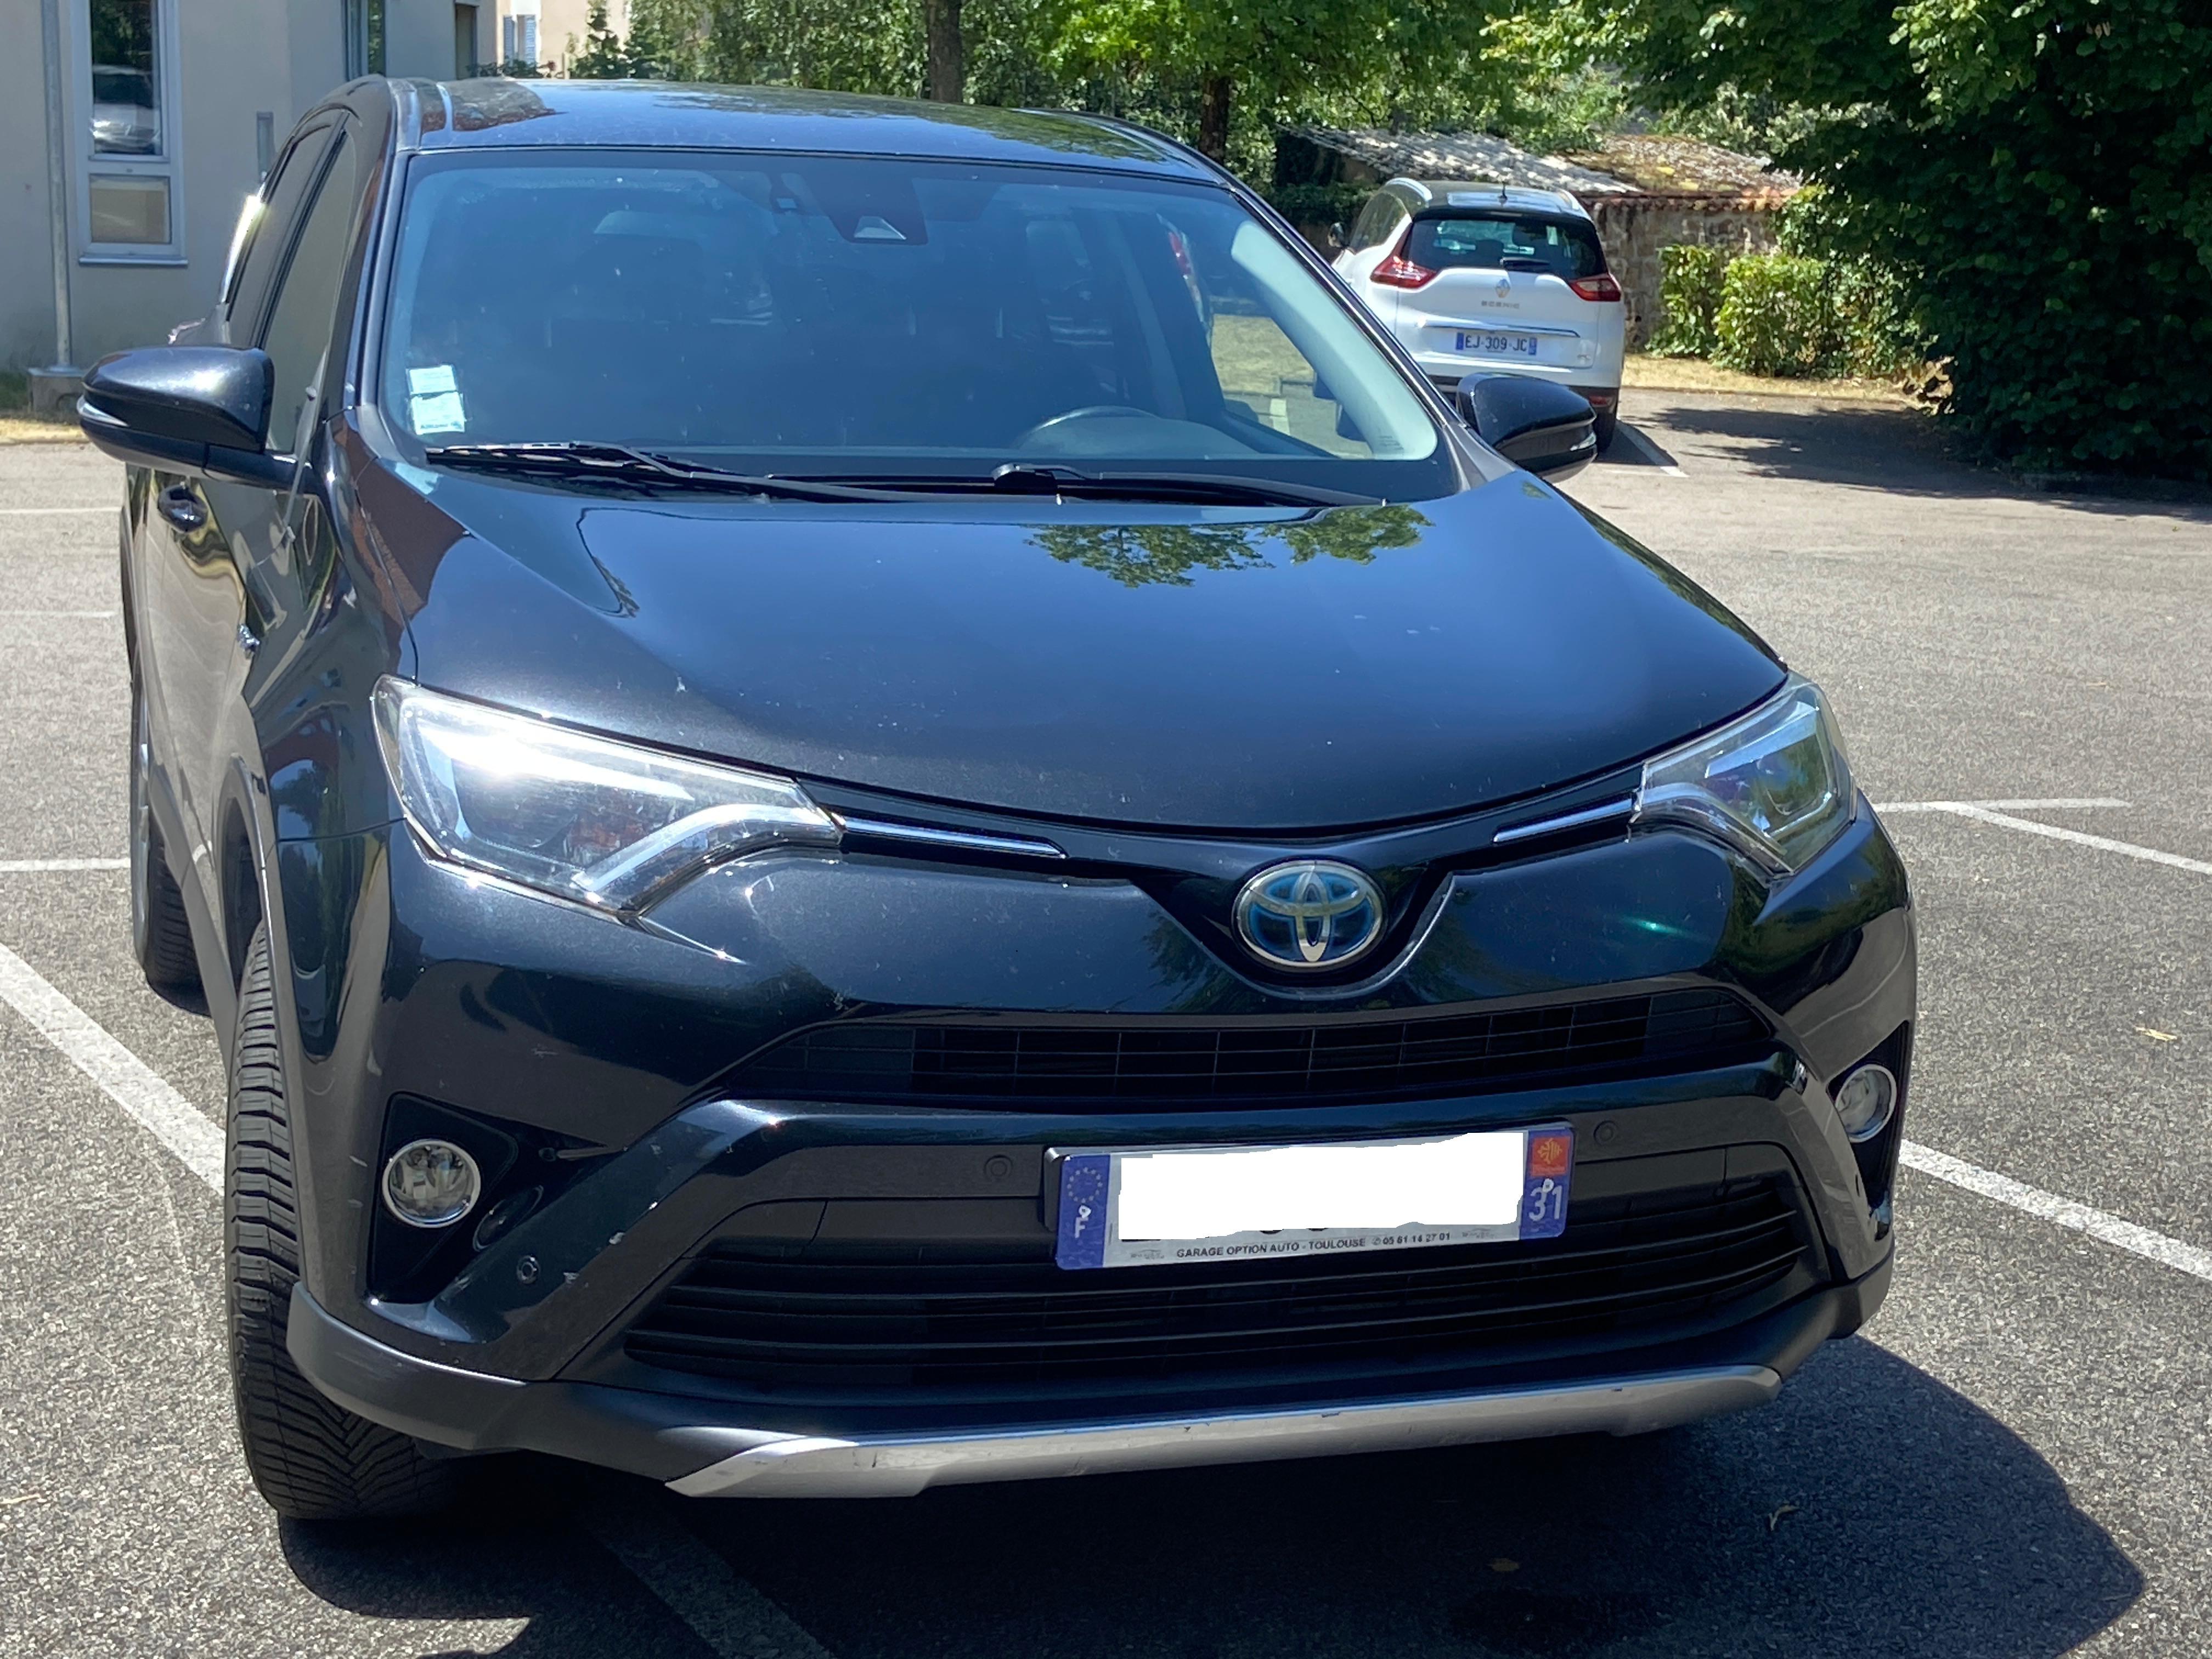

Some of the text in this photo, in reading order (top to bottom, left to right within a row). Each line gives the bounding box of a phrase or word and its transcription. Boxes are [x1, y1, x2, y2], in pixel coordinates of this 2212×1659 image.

[1528, 1185, 1562, 1221] 31
[1177, 1246, 1223, 1257] GARAGE
[1227, 1244, 1267, 1255] OPTION
[1270, 1242, 1300, 1252] AUTO
[1309, 1238, 1365, 1249] TOULOUSE
